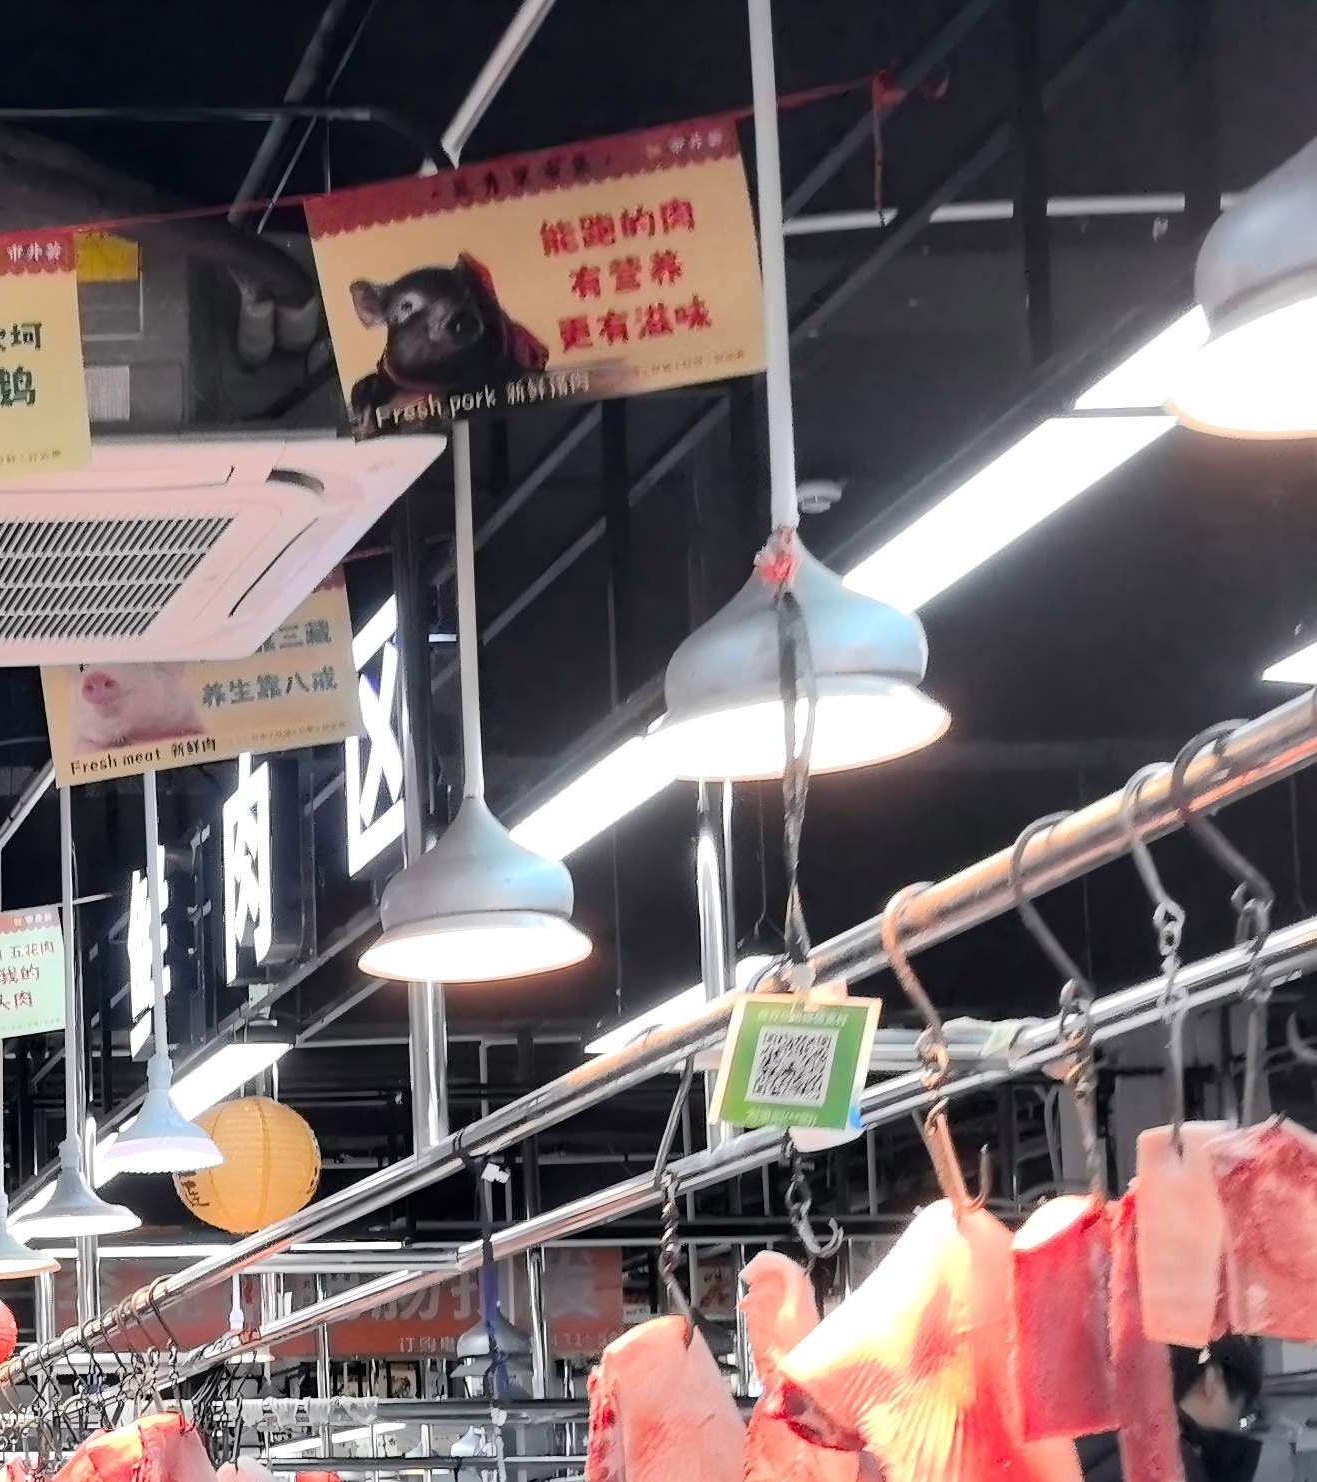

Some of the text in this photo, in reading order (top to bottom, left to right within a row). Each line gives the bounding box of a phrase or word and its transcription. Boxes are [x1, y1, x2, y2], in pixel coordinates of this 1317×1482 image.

[540, 198, 696, 257] 能跑的肉
[569, 249, 684, 300] 有营养
[559, 295, 712, 354] 更有滋味
[376, 396, 441, 429] Fresh
[450, 384, 496, 419] pork
[202, 666, 337, 707] 养生靠八戒
[71, 738, 216, 776] Fresh meat 新鲜肉
[10, 941, 54, 959] 五花肉
